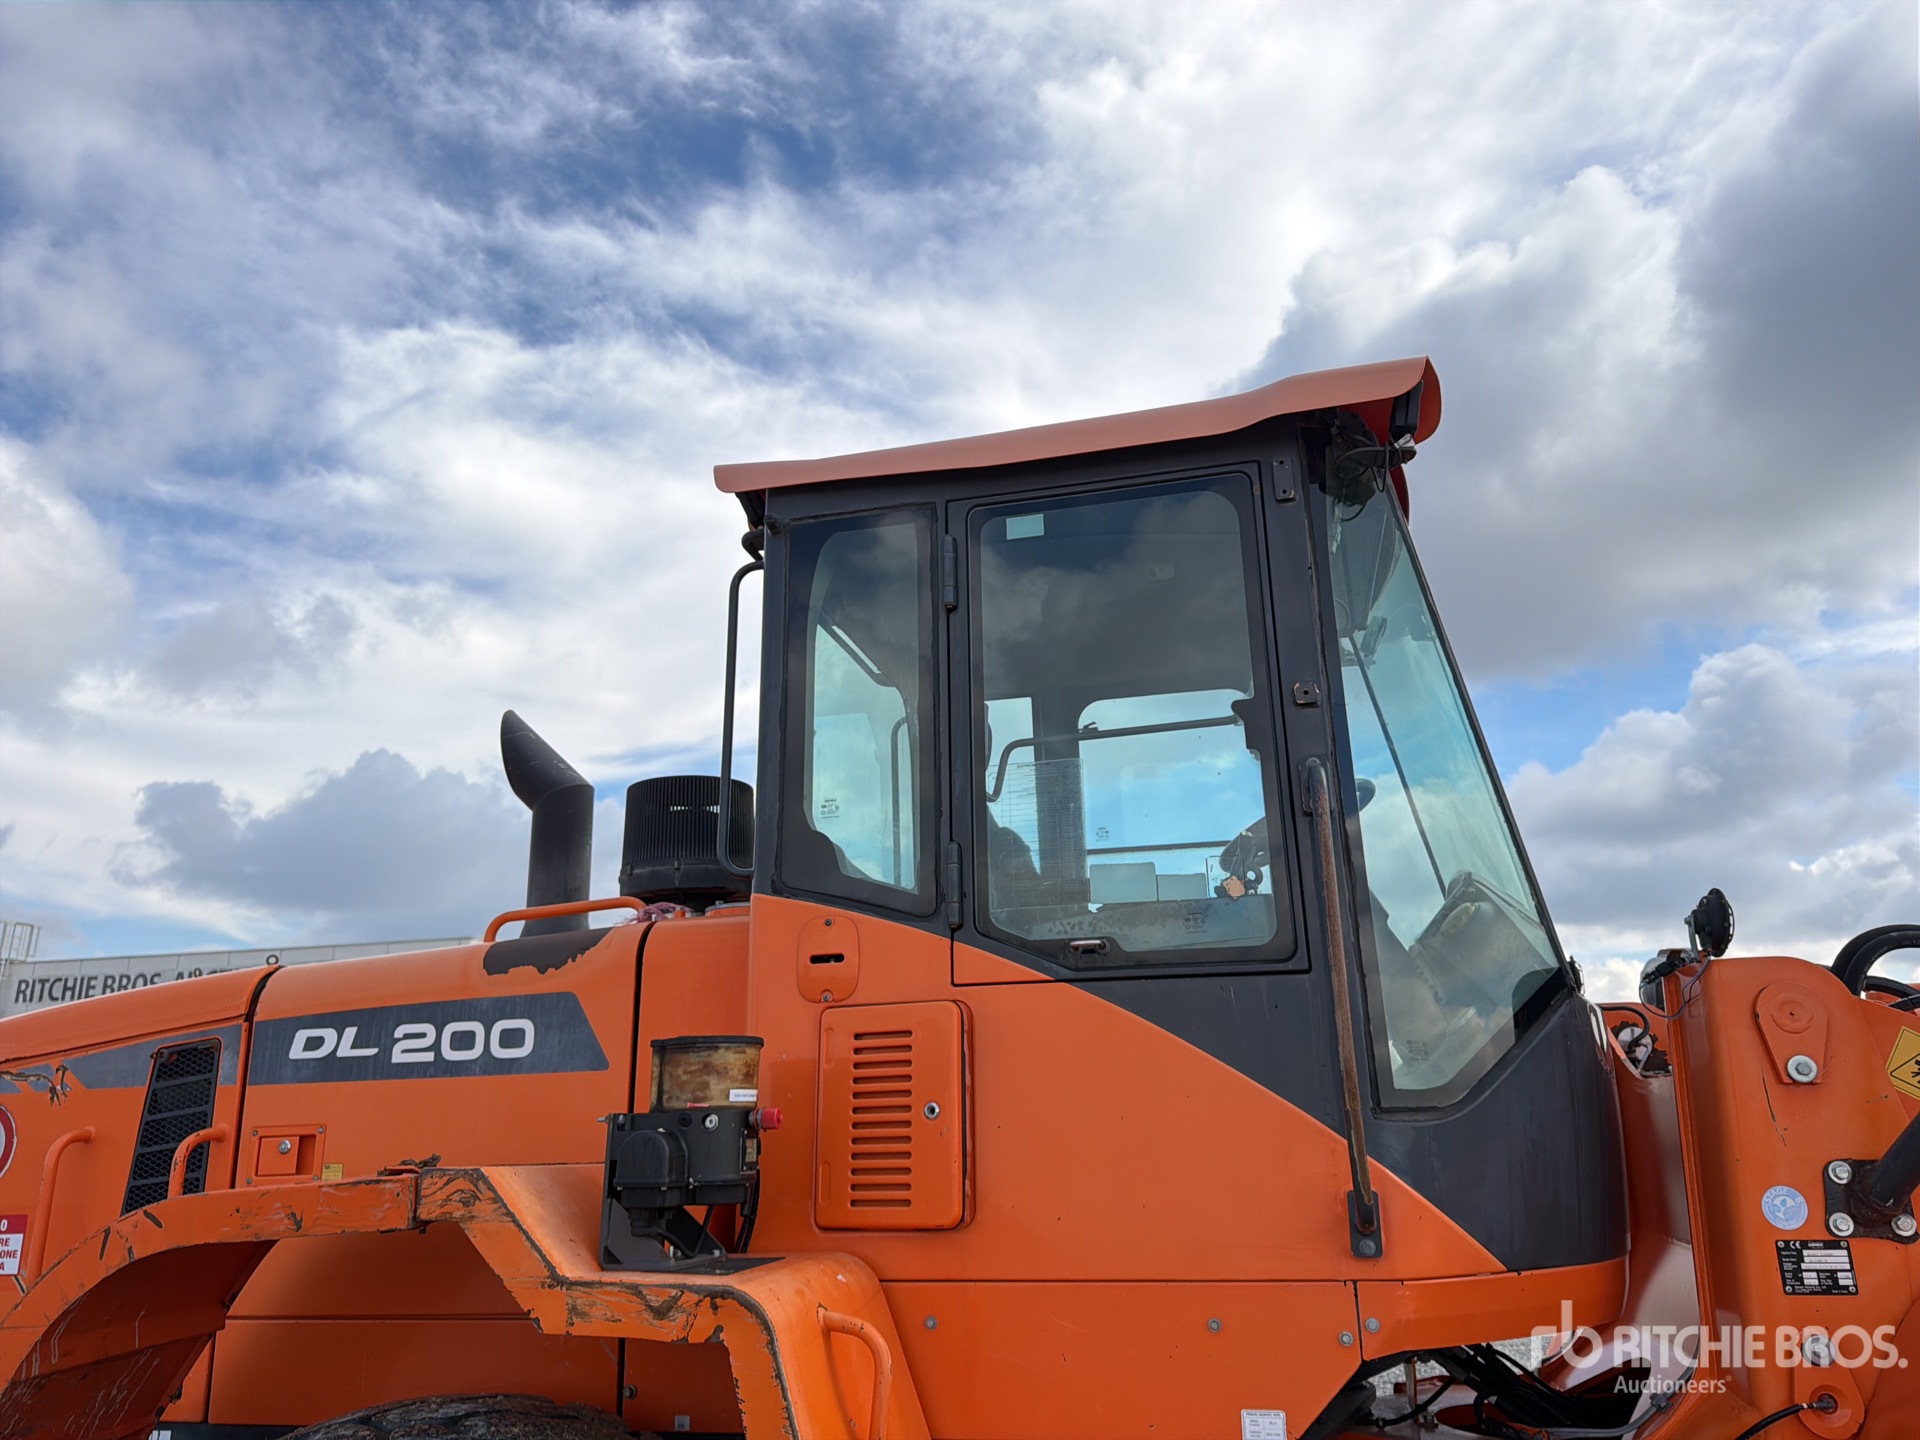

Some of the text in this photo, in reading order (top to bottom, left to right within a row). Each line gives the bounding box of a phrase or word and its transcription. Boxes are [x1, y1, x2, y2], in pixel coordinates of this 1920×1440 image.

[15, 976, 98, 1004] RITCHIE
[288, 1018, 535, 1064] DL 200
